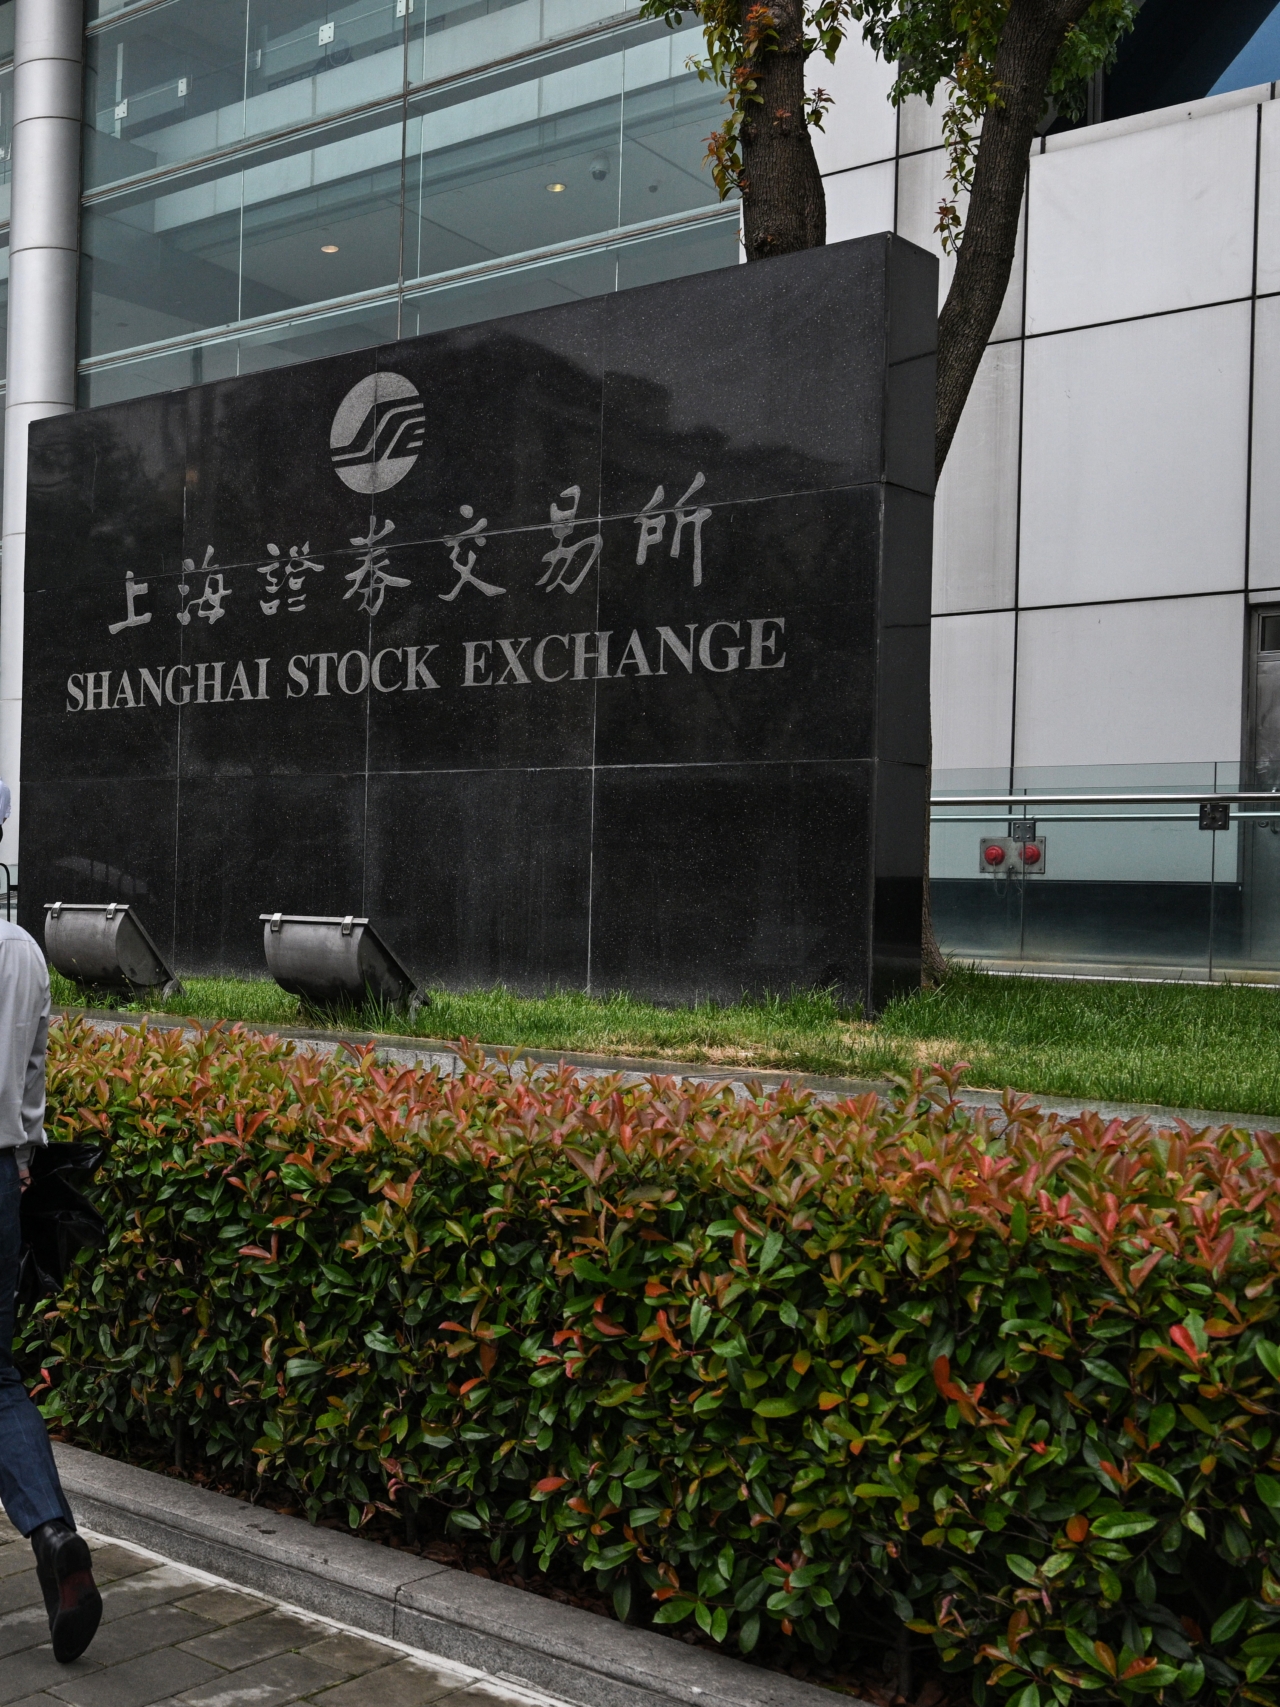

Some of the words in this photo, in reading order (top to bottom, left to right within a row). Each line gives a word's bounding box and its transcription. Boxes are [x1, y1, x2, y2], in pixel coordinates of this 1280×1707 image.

[108, 471, 713, 635] 上海證券交易所
[66, 657, 271, 713] SHANGHAI
[286, 643, 442, 700] STOCK
[460, 617, 787, 688] EXCHANGE
